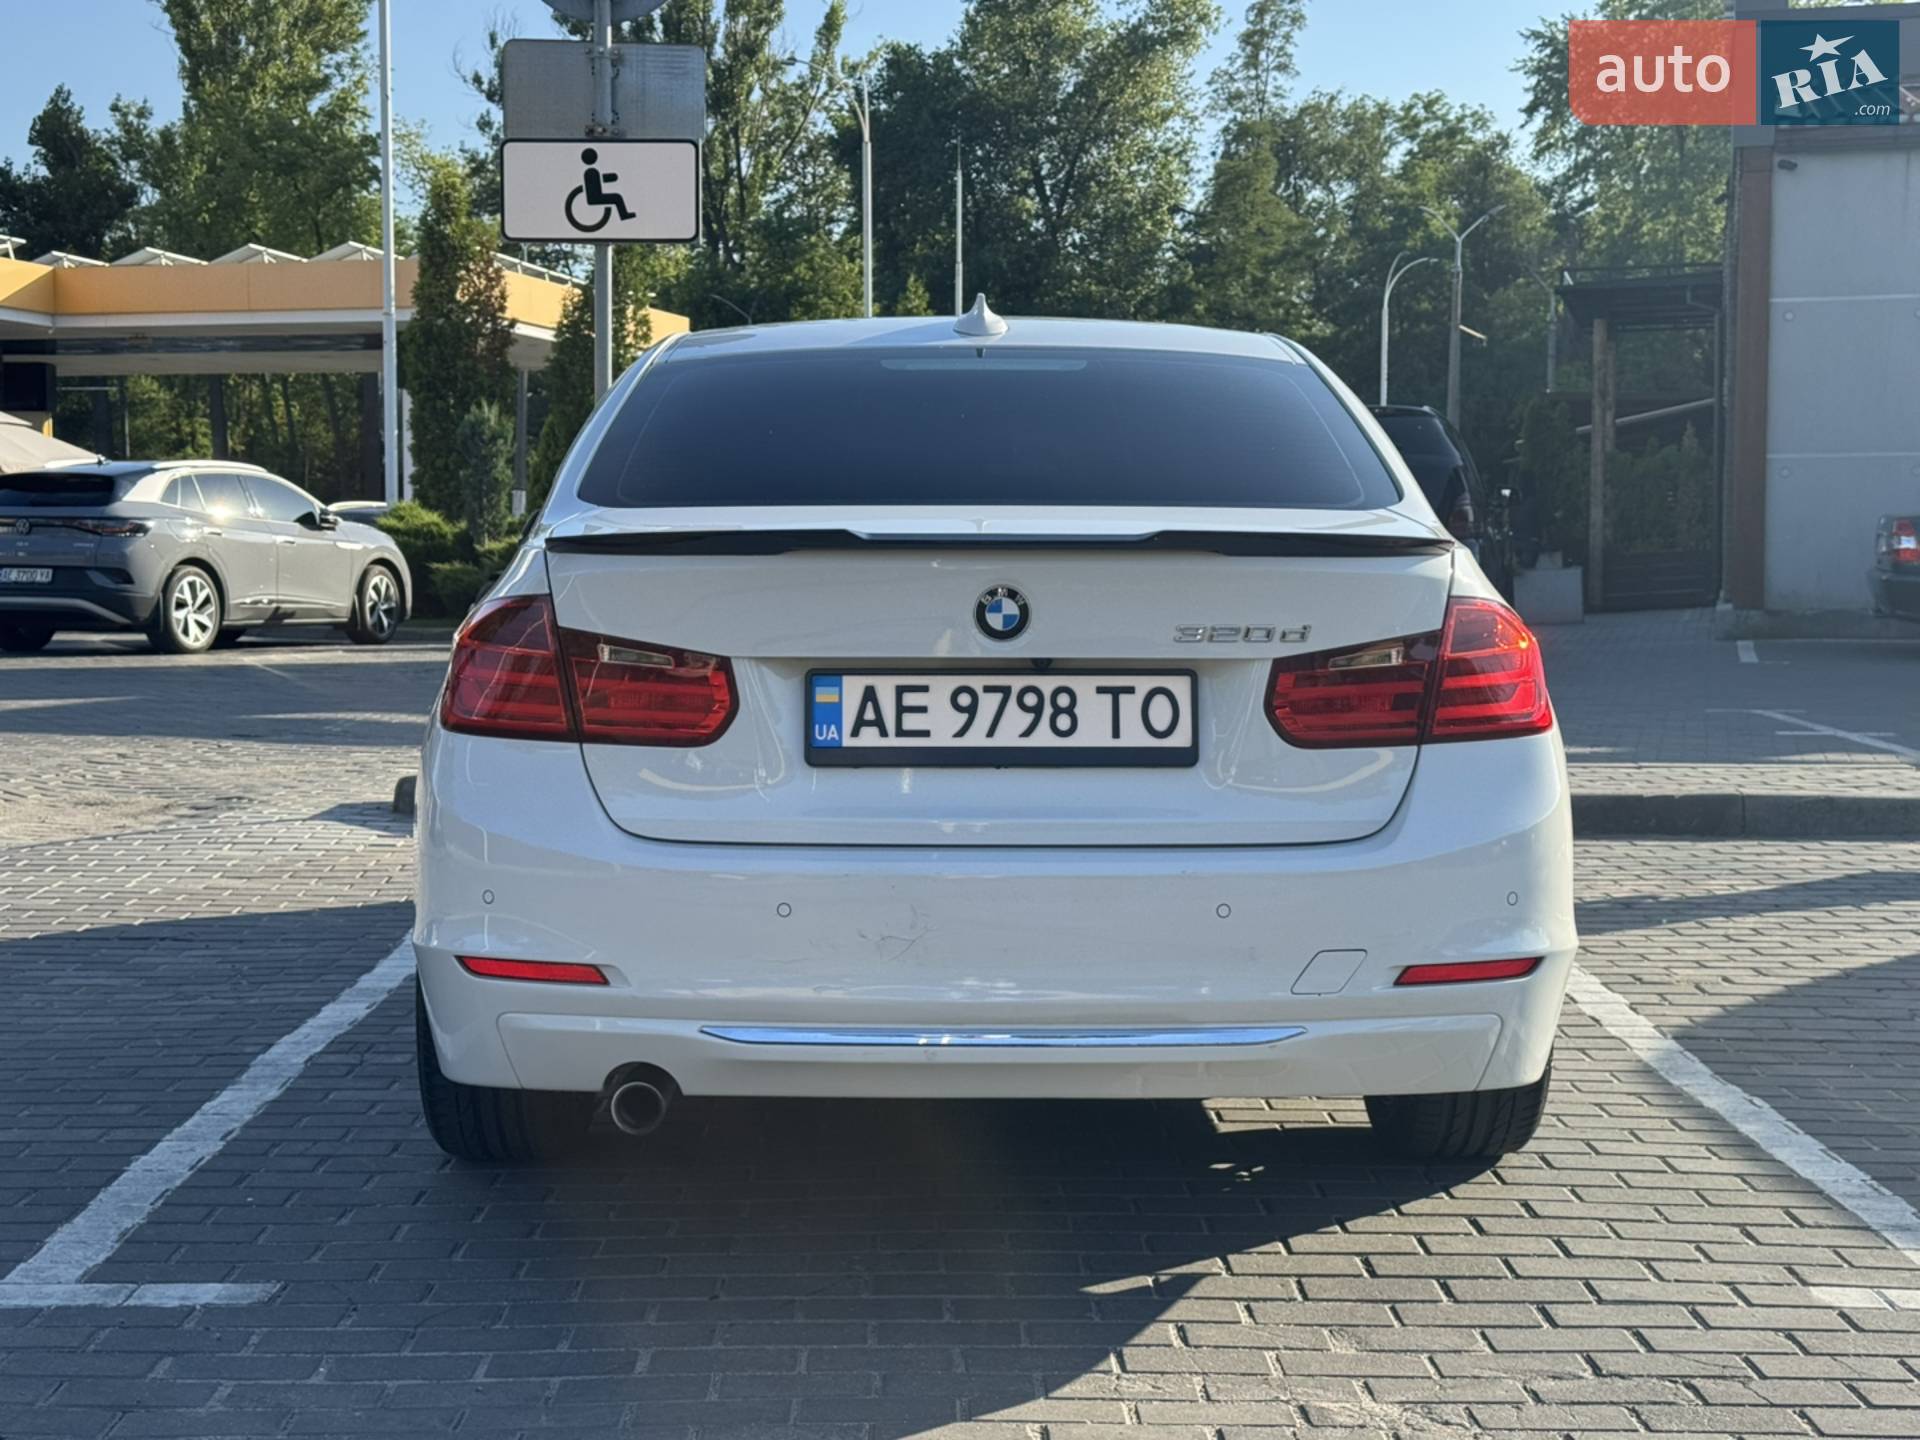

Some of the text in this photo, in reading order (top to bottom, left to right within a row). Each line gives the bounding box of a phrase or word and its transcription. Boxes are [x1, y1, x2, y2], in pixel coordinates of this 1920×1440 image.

[1173, 624, 1312, 643] 320d
[850, 685, 1181, 740] AE 9798 TO
[814, 724, 840, 741] UA
